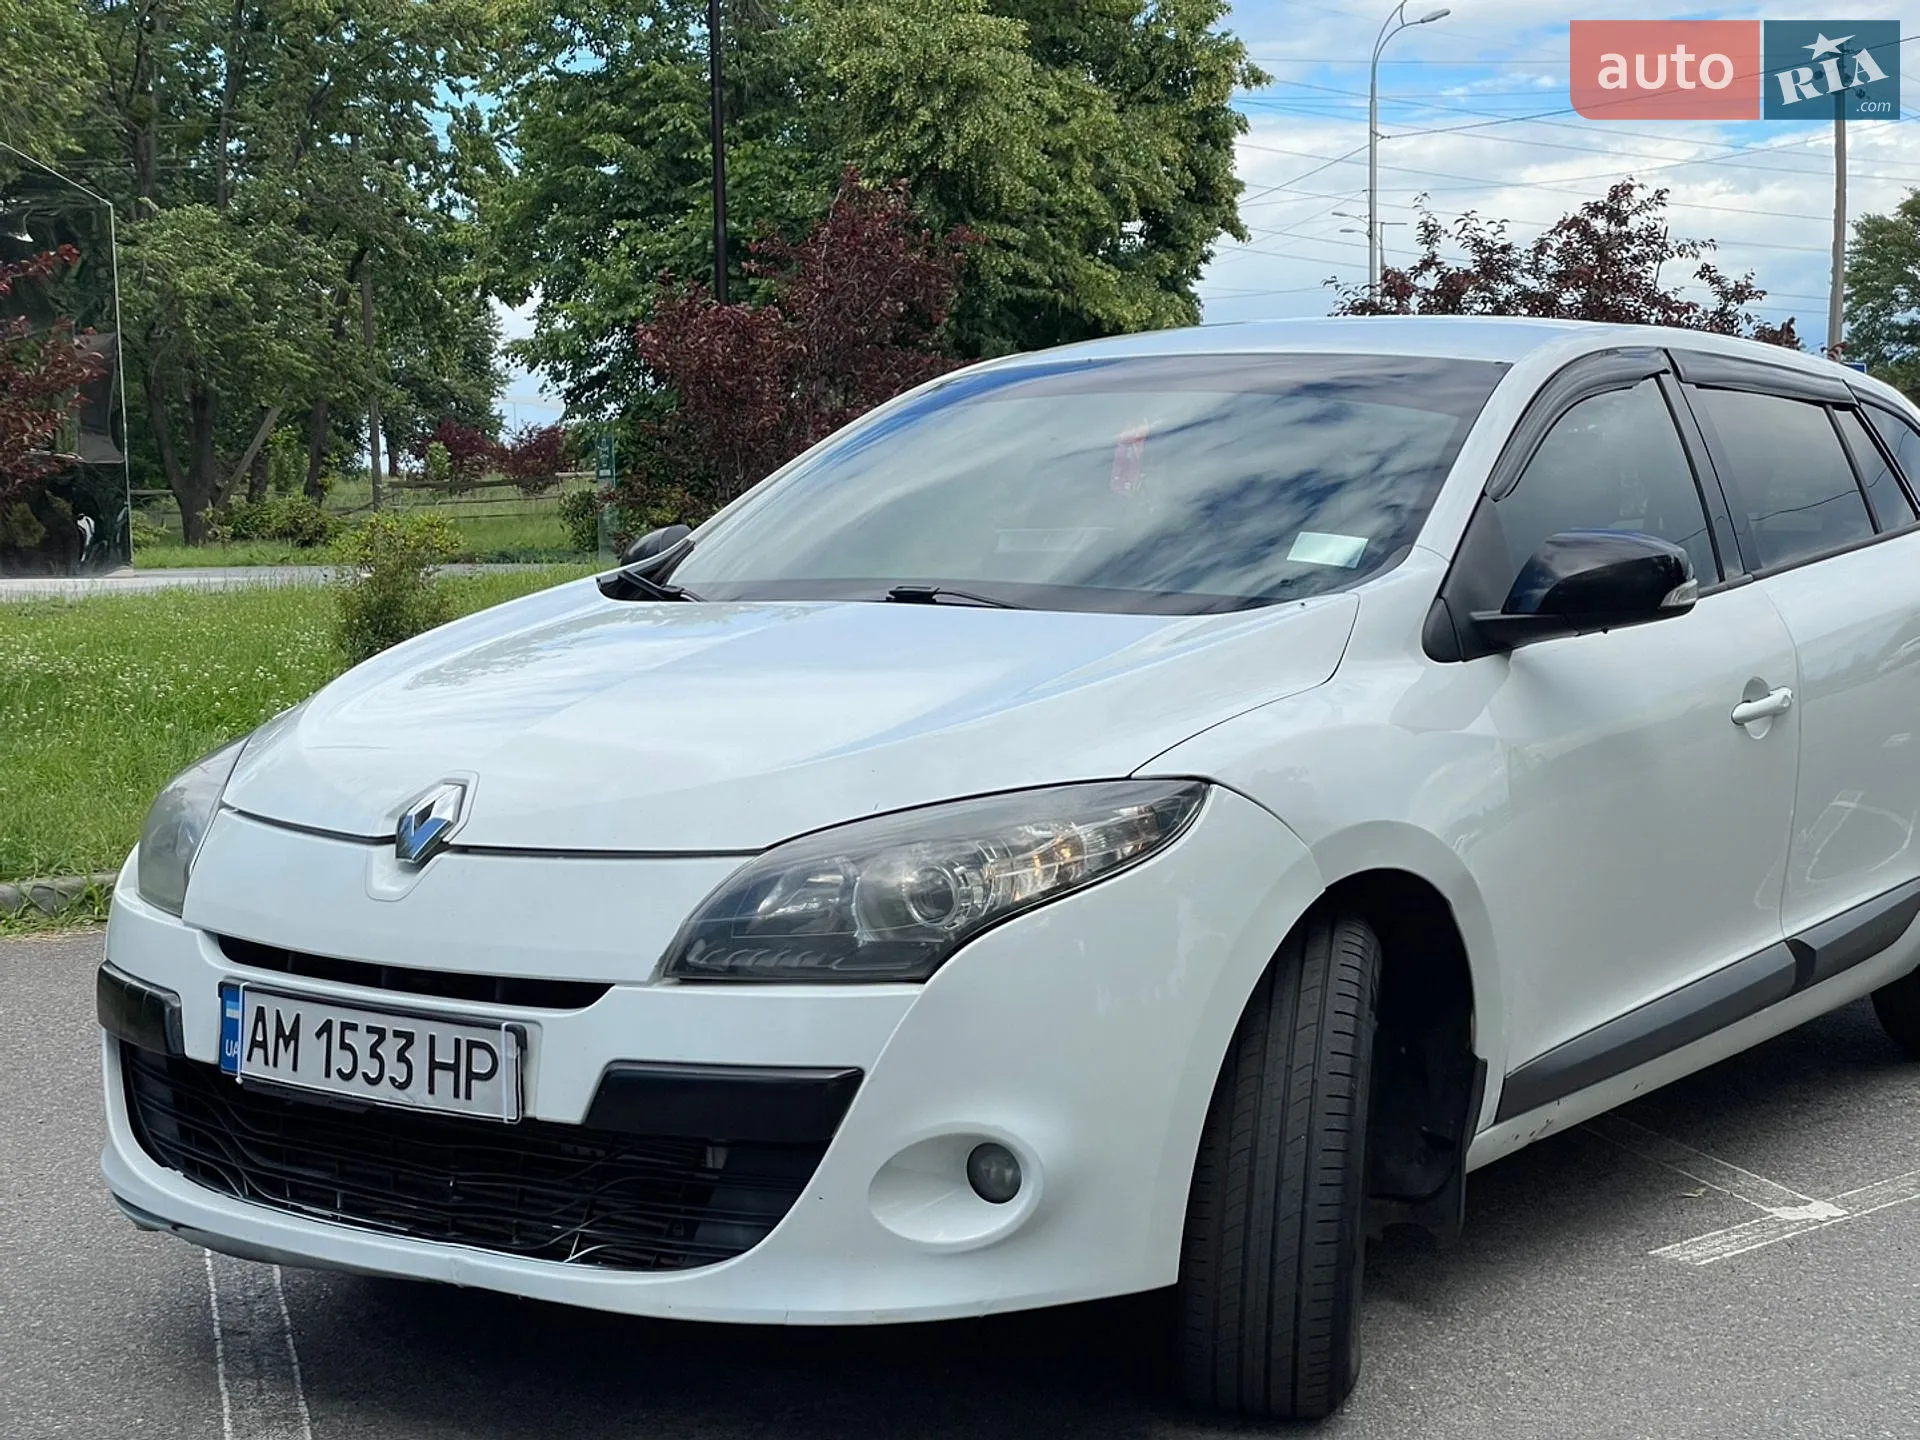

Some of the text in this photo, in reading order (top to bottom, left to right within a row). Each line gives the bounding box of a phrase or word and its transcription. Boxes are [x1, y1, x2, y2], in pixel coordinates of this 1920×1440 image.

[247, 1005, 499, 1100] AM 1533 HP
